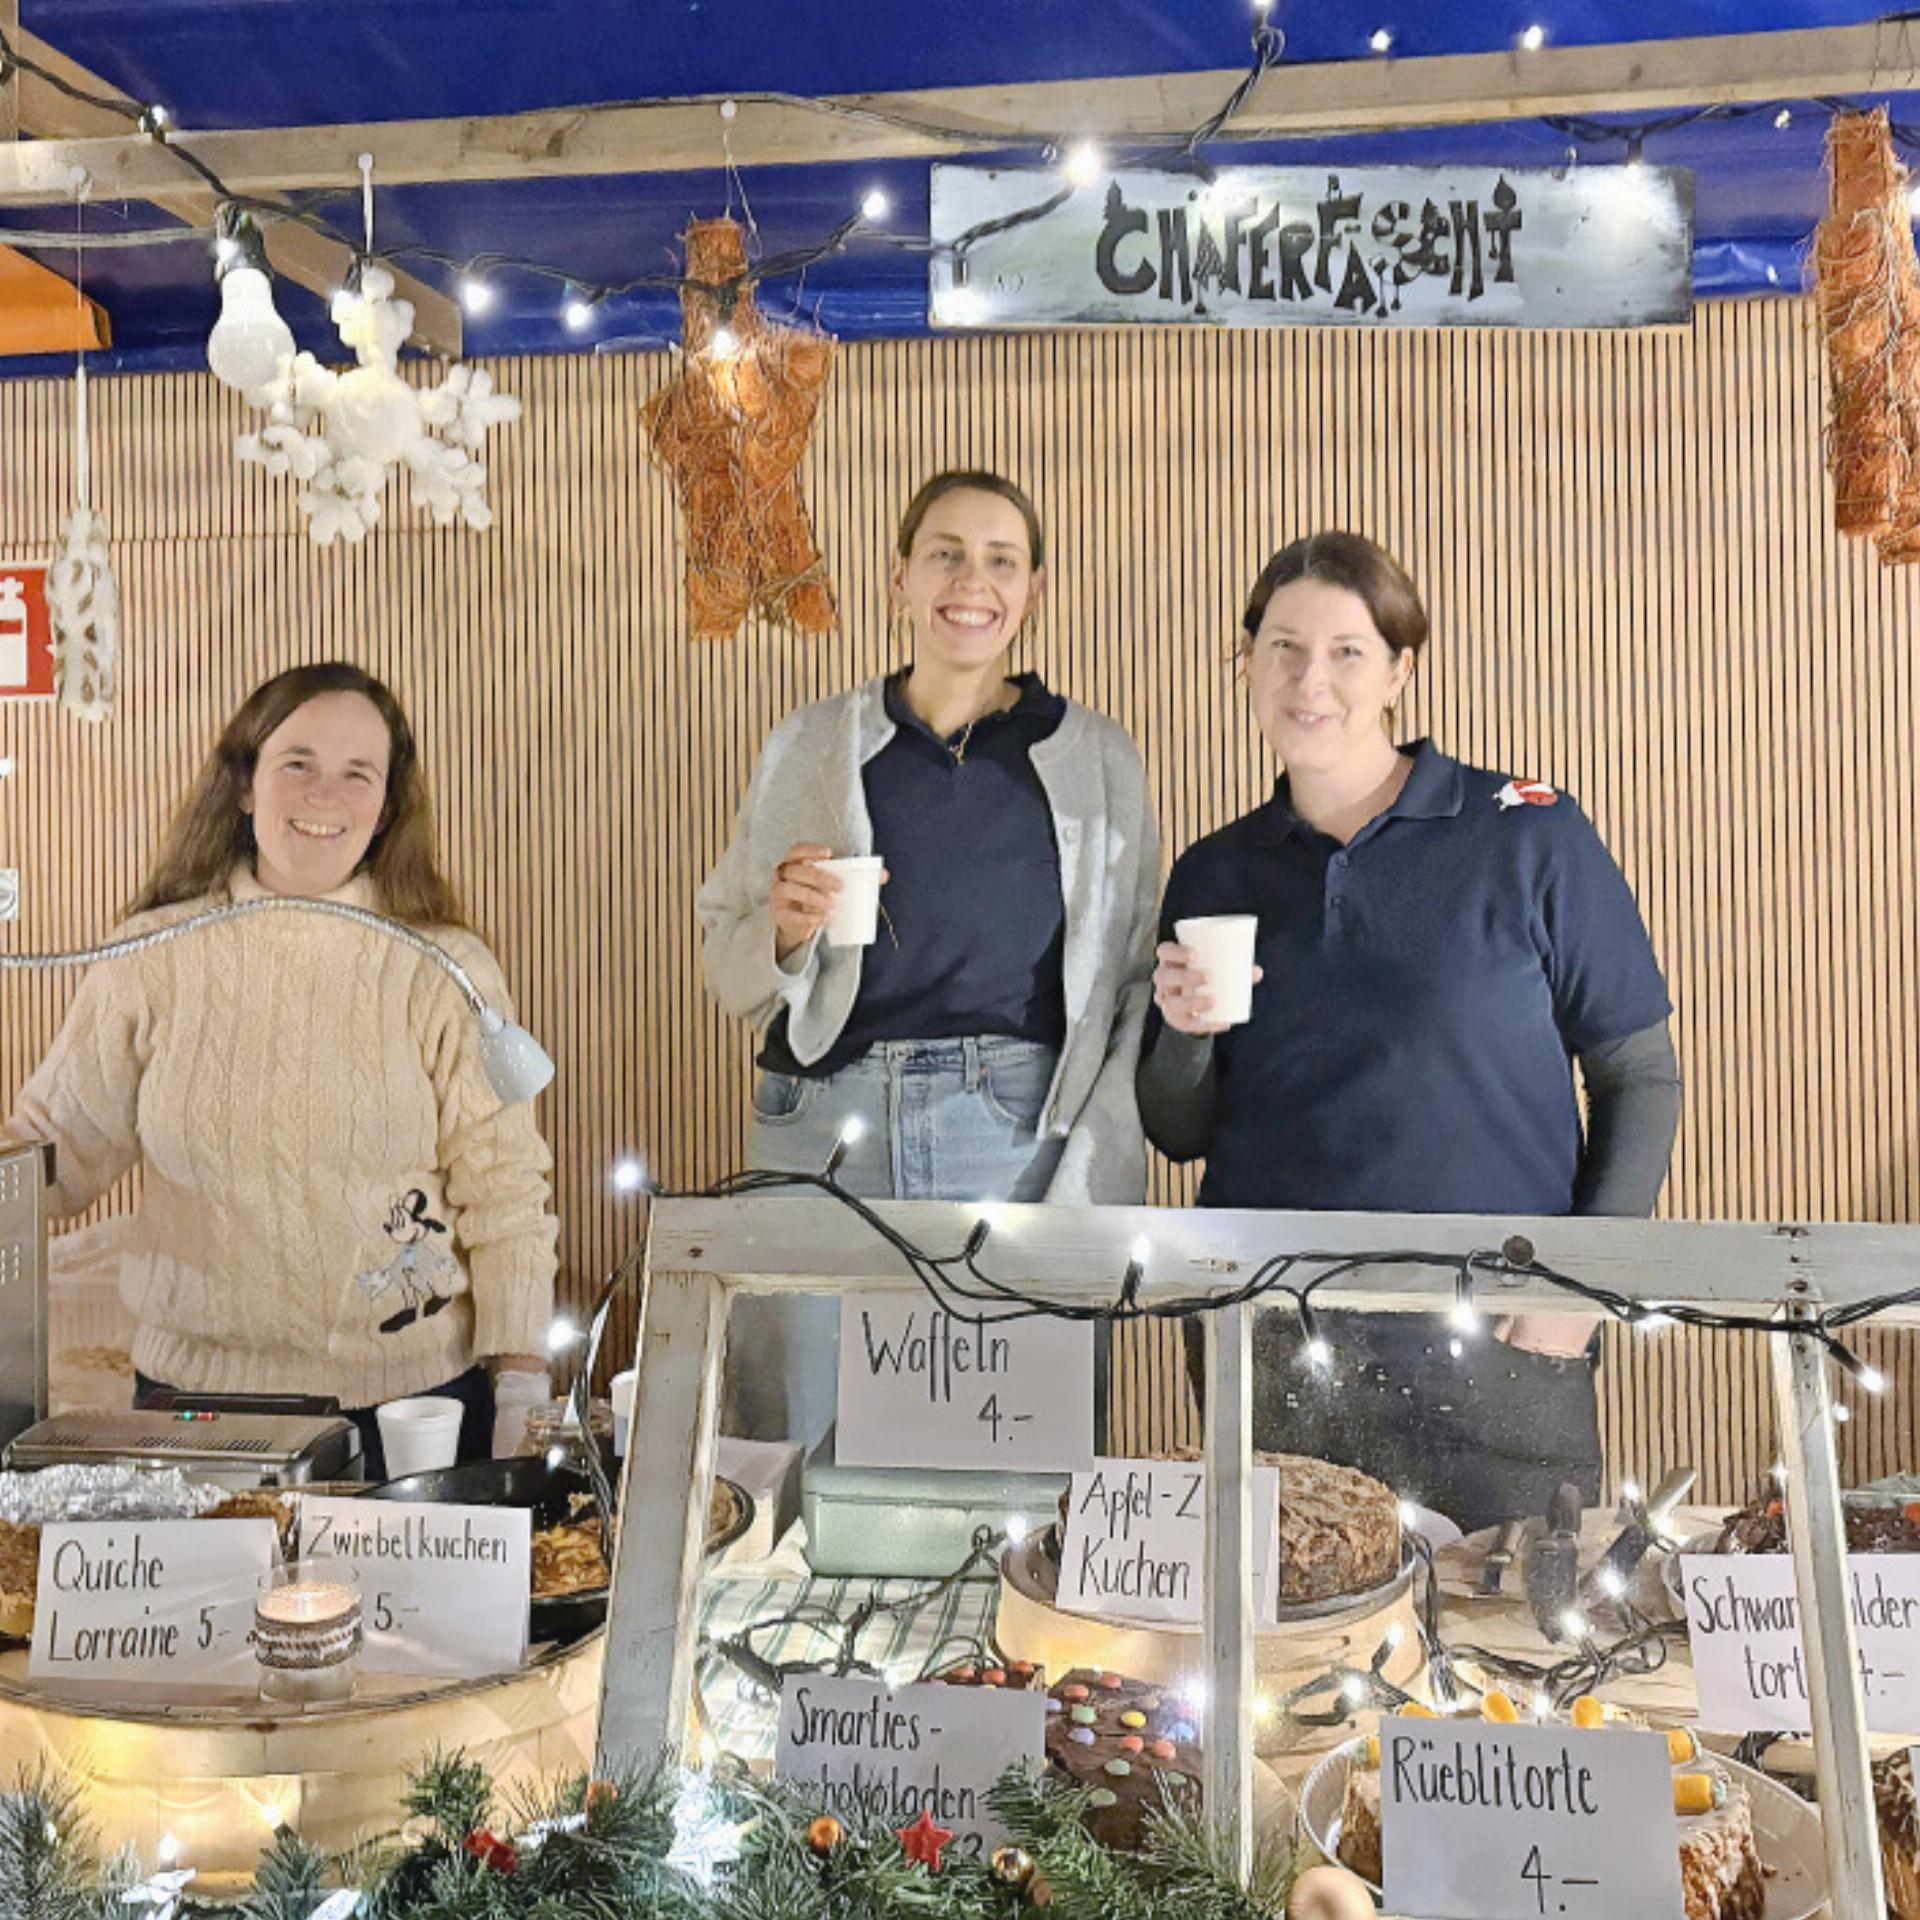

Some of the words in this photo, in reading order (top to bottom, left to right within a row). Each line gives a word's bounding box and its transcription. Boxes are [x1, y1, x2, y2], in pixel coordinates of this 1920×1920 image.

[862, 1310, 1011, 1402] Waffeln
[1079, 1471, 1203, 1541] Apfel-Z
[52, 1533, 165, 1594] Quiche
[305, 1515, 508, 1564] Zwiebelkuchen
[1078, 1535, 1191, 1601] Kuchen
[47, 1605, 178, 1662] Lorraine
[1692, 1571, 1919, 1635] Schwarlder
[1744, 1644, 1809, 1700] tort
[790, 1686, 943, 1751] Smarties-
[802, 1762, 976, 1822] hokoladen
[1392, 1735, 1599, 1816] Rüeblitorte
